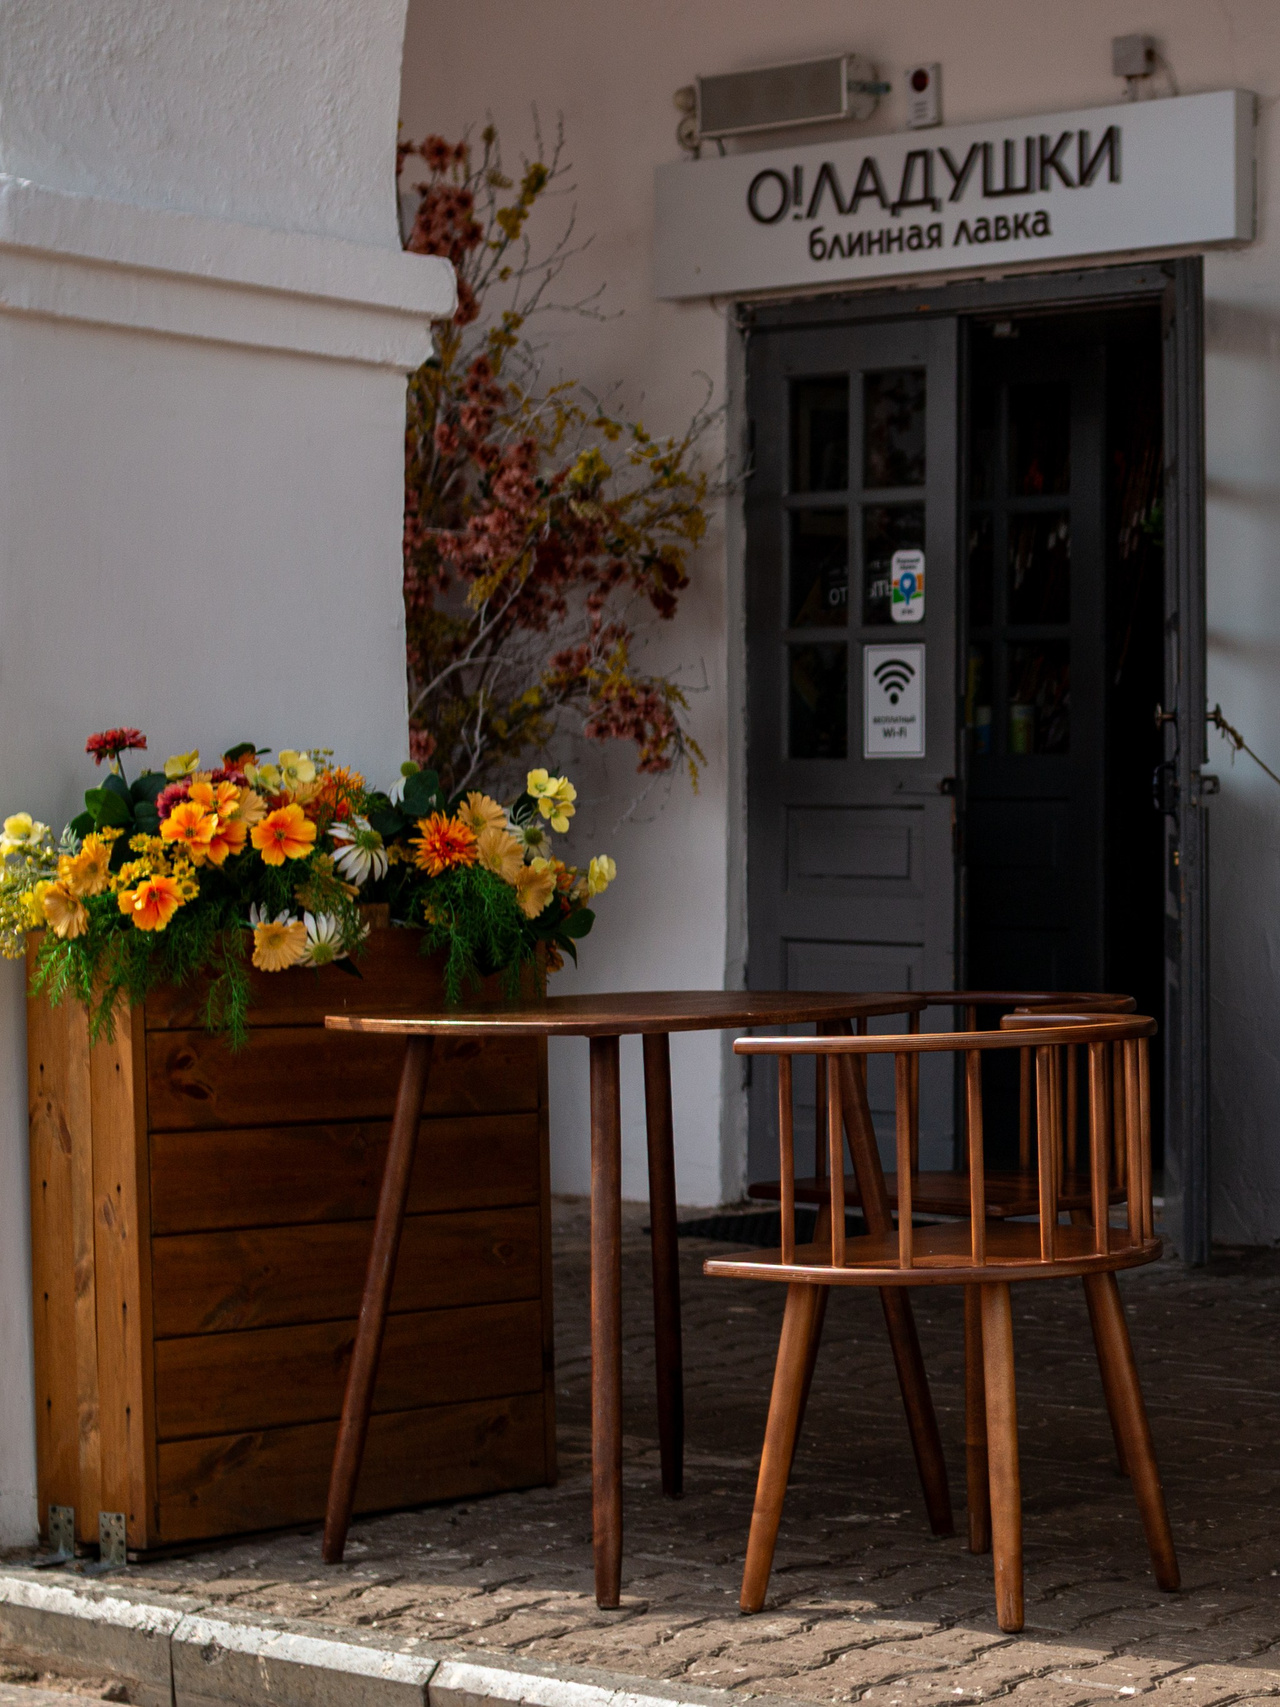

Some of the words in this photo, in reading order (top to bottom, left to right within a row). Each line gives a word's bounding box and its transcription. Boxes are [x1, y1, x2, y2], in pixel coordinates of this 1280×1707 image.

[746, 124, 1122, 225] О!ЛАДУШКИ
[808, 220, 943, 262] блинная
[953, 209, 1052, 247] лавка
[883, 726, 908, 738] Wi-Fi
